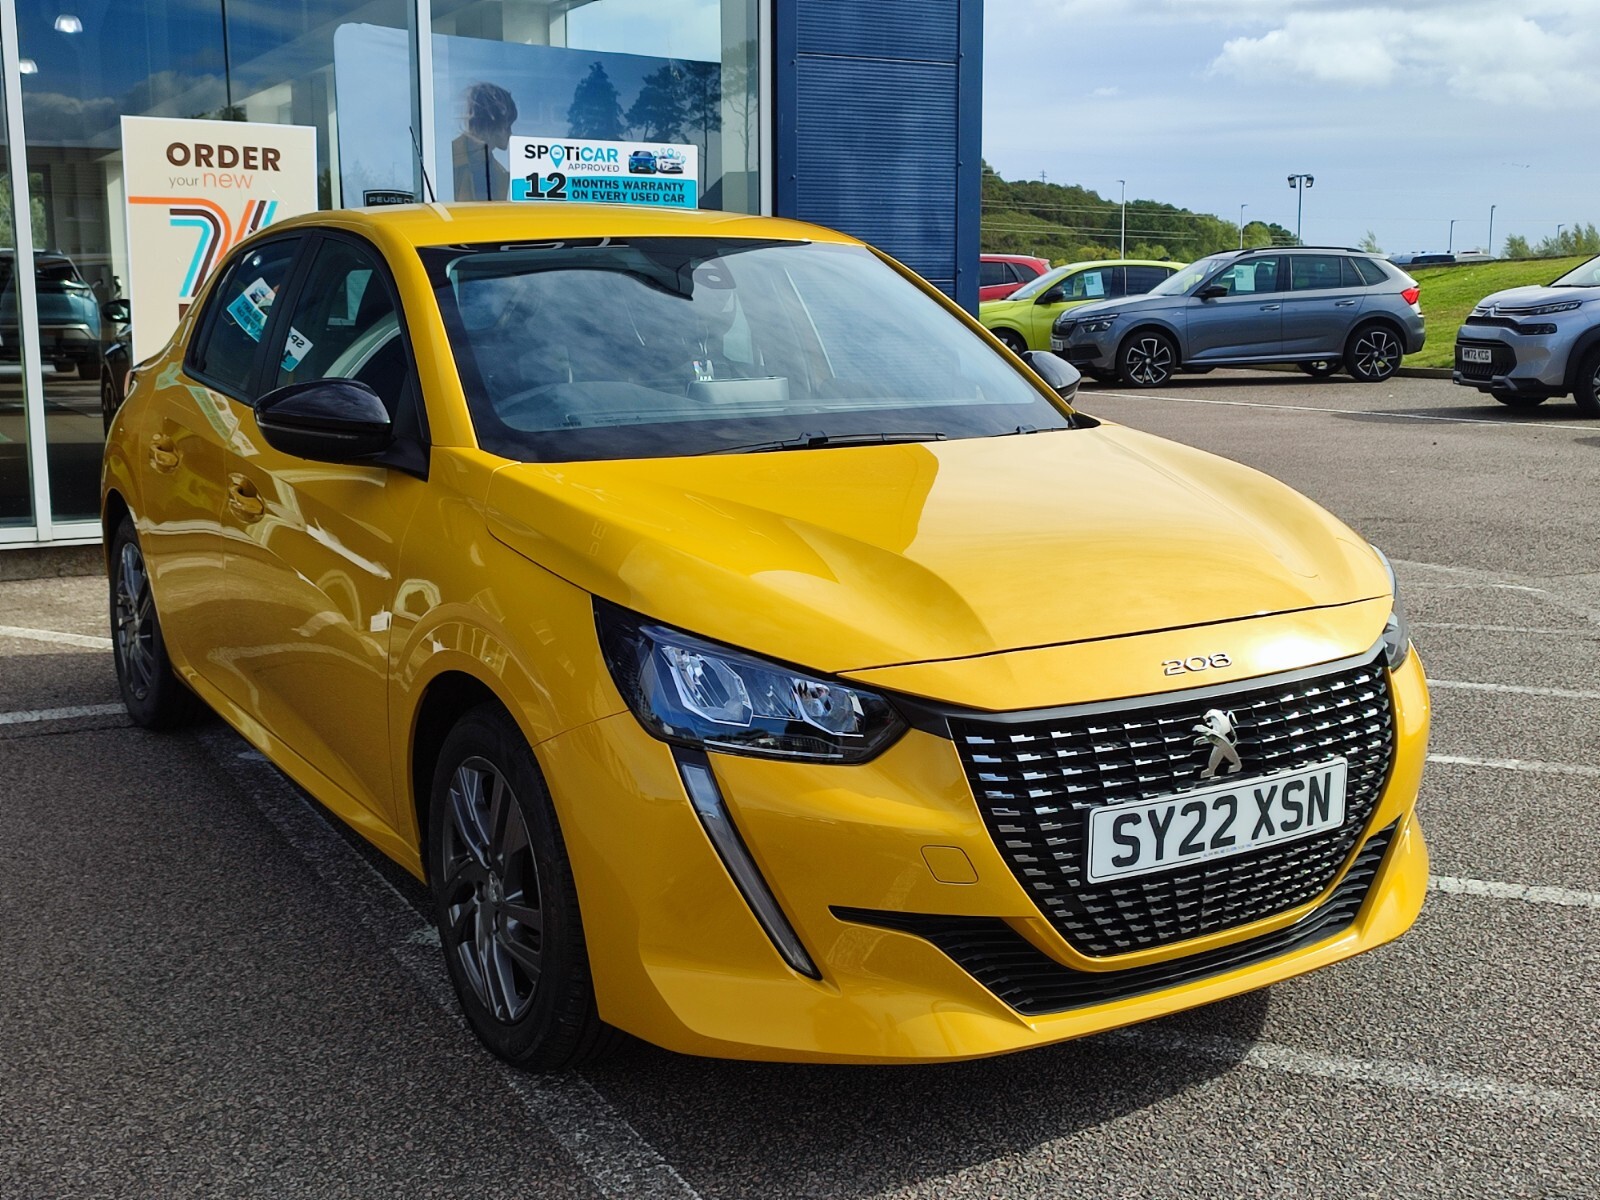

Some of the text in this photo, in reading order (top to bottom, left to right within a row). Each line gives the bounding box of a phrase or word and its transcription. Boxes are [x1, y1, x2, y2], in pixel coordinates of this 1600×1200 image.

[166, 142, 281, 171] ORDER
[567, 163, 620, 173] APPROVED
[169, 172, 253, 189] your new
[525, 172, 567, 199] 12
[571, 179, 685, 192] MONTHS WARRANTY
[572, 189, 685, 203] ON EVERY USED CAR
[1162, 652, 1233, 676] 208
[1111, 772, 1332, 868] SY22 XSN
